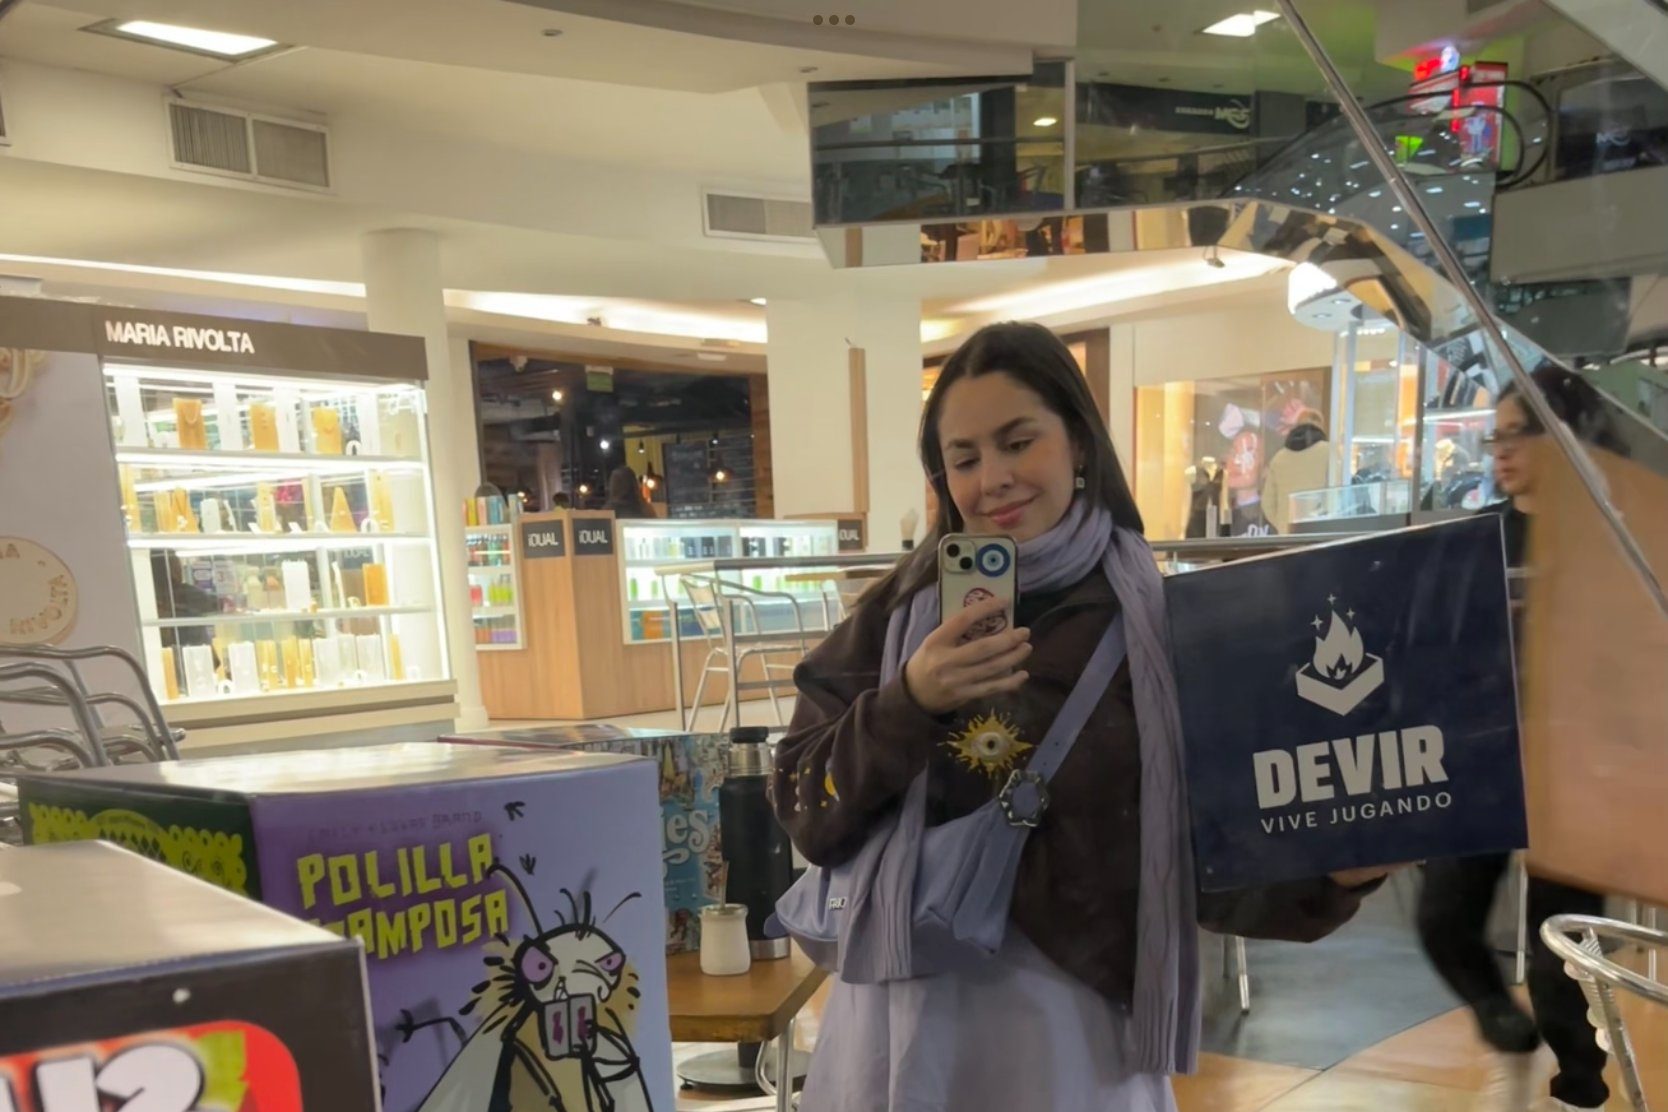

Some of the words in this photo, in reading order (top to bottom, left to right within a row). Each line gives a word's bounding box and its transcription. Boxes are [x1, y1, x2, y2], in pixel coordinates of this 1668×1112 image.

[105, 320, 171, 347] MARIA
[172, 326, 255, 354] RIVOLTA
[1253, 724, 1449, 809] DEVIR
[1261, 811, 1319, 834] VIVE
[1329, 792, 1452, 825] JUGANDO
[297, 833, 496, 910] POLILLA
[308, 889, 510, 959] AMPOSA
